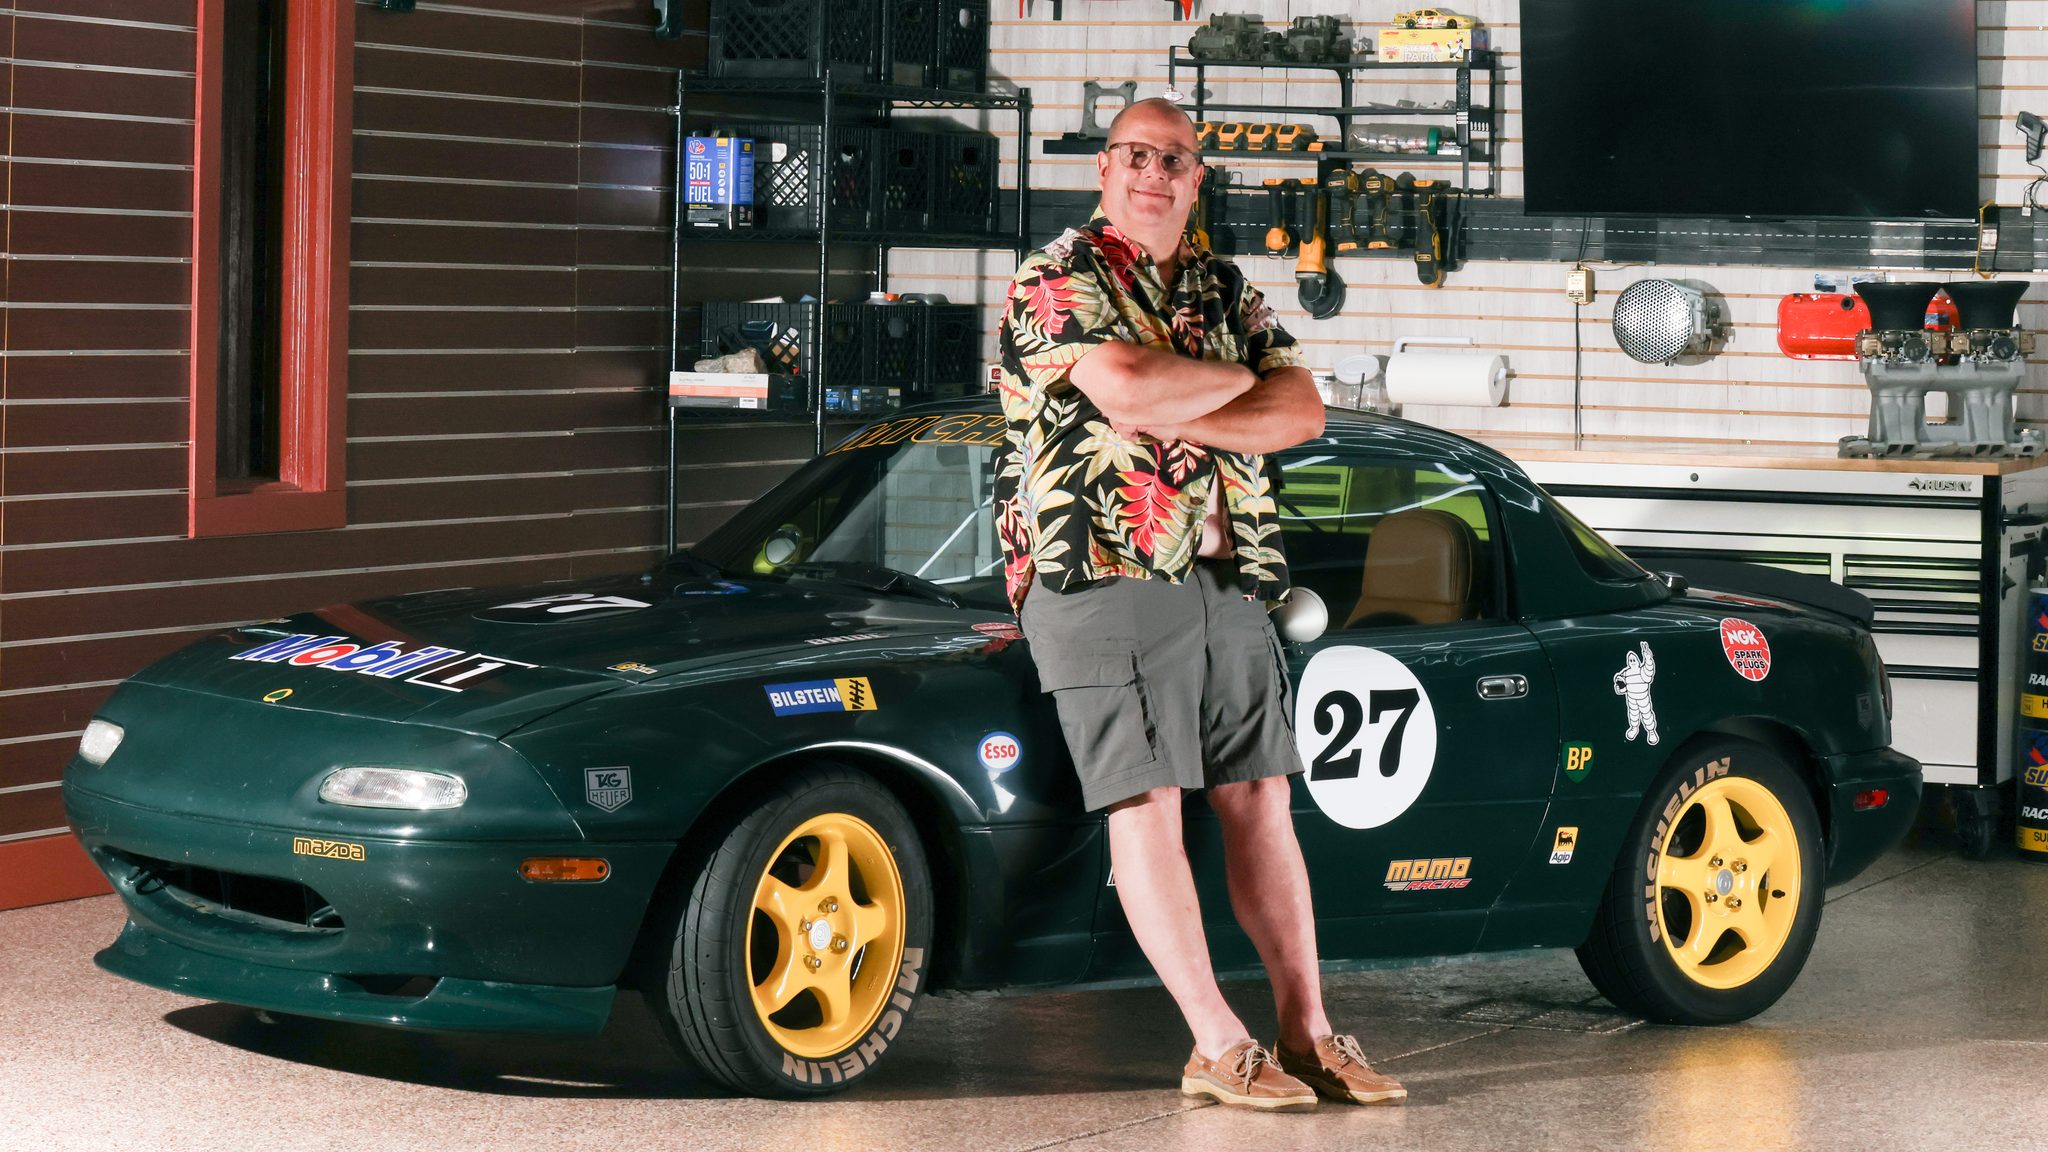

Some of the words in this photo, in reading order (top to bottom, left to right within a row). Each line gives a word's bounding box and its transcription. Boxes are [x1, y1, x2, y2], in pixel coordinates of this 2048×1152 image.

[690, 162, 711, 180] 50:1
[689, 186, 714, 203] FUEL
[1726, 630, 1759, 645] NGK
[228, 634, 466, 679] Mobil
[440, 661, 506, 684] 1
[1734, 650, 1762, 659] SPARK
[1737, 660, 1766, 669] PLUGS
[769, 687, 842, 708] BILSTEIN
[1310, 688, 1421, 782] 27
[1566, 747, 1593, 770] BP
[595, 773, 622, 788] TAG
[592, 790, 628, 807] HEUER
[2033, 832, 2048, 843] SU
[1551, 852, 1571, 863] Agip
[1645, 756, 1731, 943] MICHELIN
[1384, 857, 1473, 882] MOMO
[1404, 878, 1473, 891] RACING
[782, 947, 924, 1085] MICHELIN
